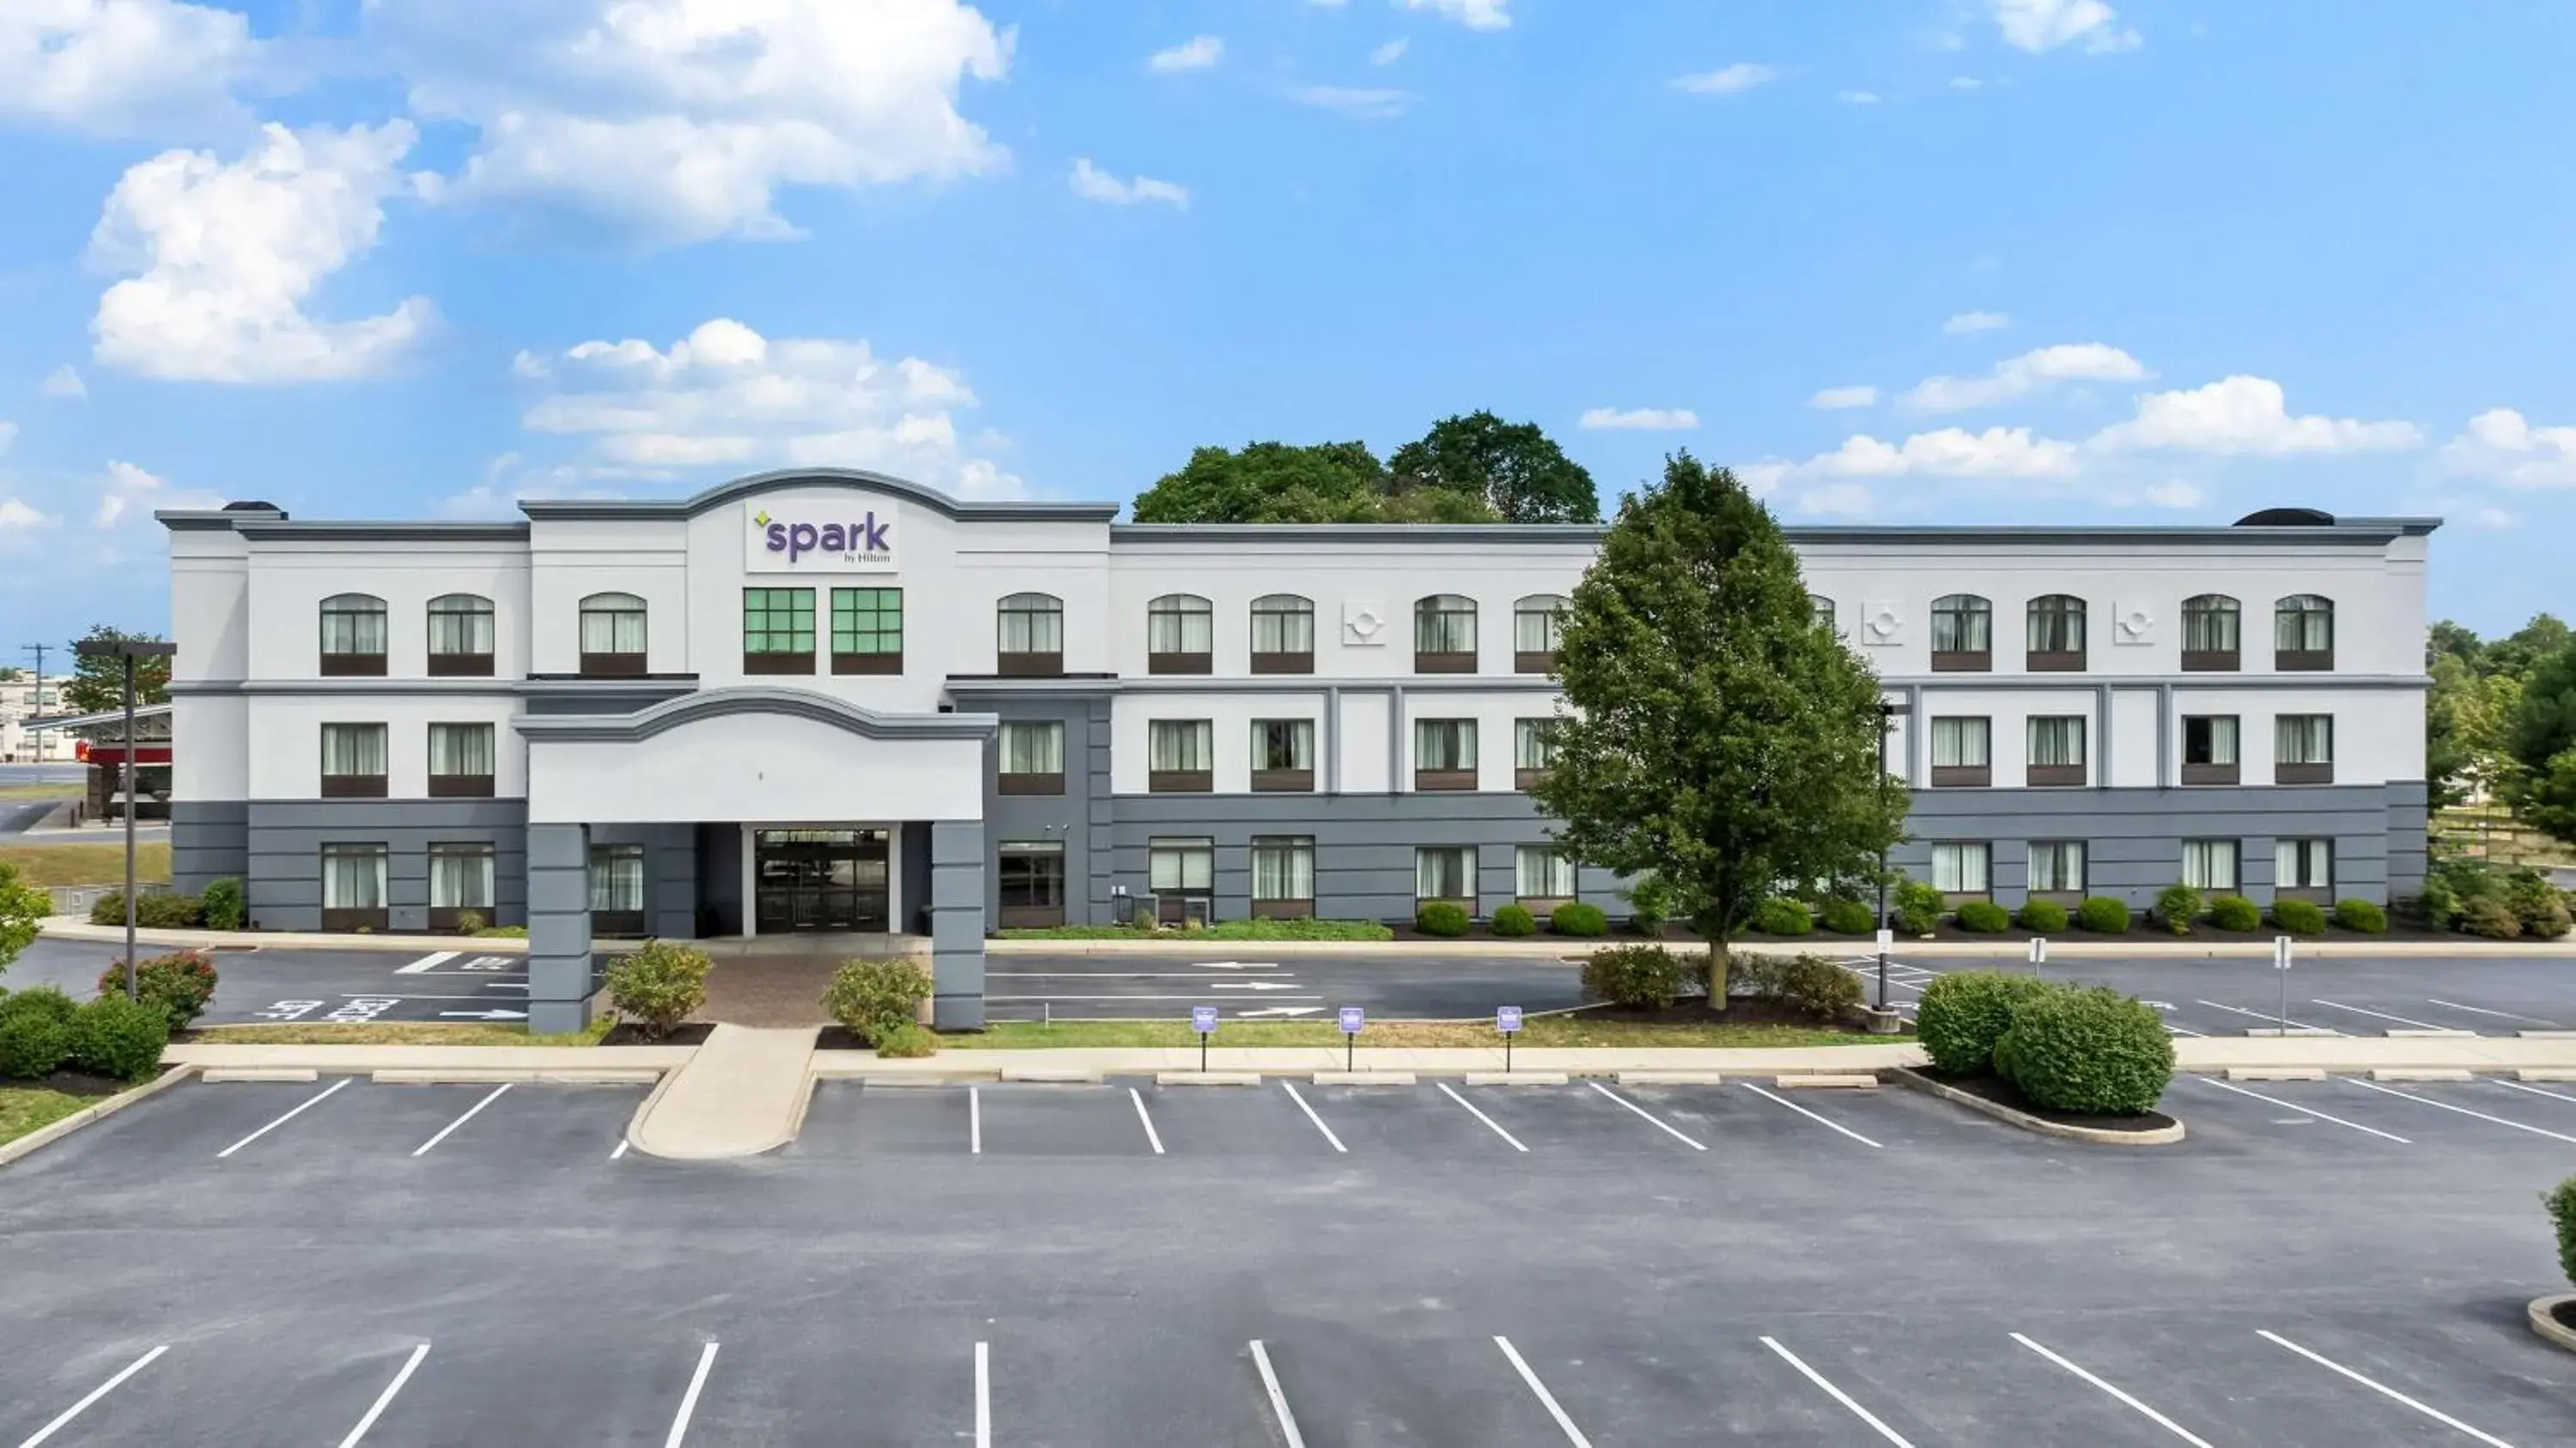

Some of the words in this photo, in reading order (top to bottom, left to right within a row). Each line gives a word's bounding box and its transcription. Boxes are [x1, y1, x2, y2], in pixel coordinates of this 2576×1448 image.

[767, 511, 890, 563] spark
[844, 552, 854, 563] by
[858, 552, 891, 563] Hilton
